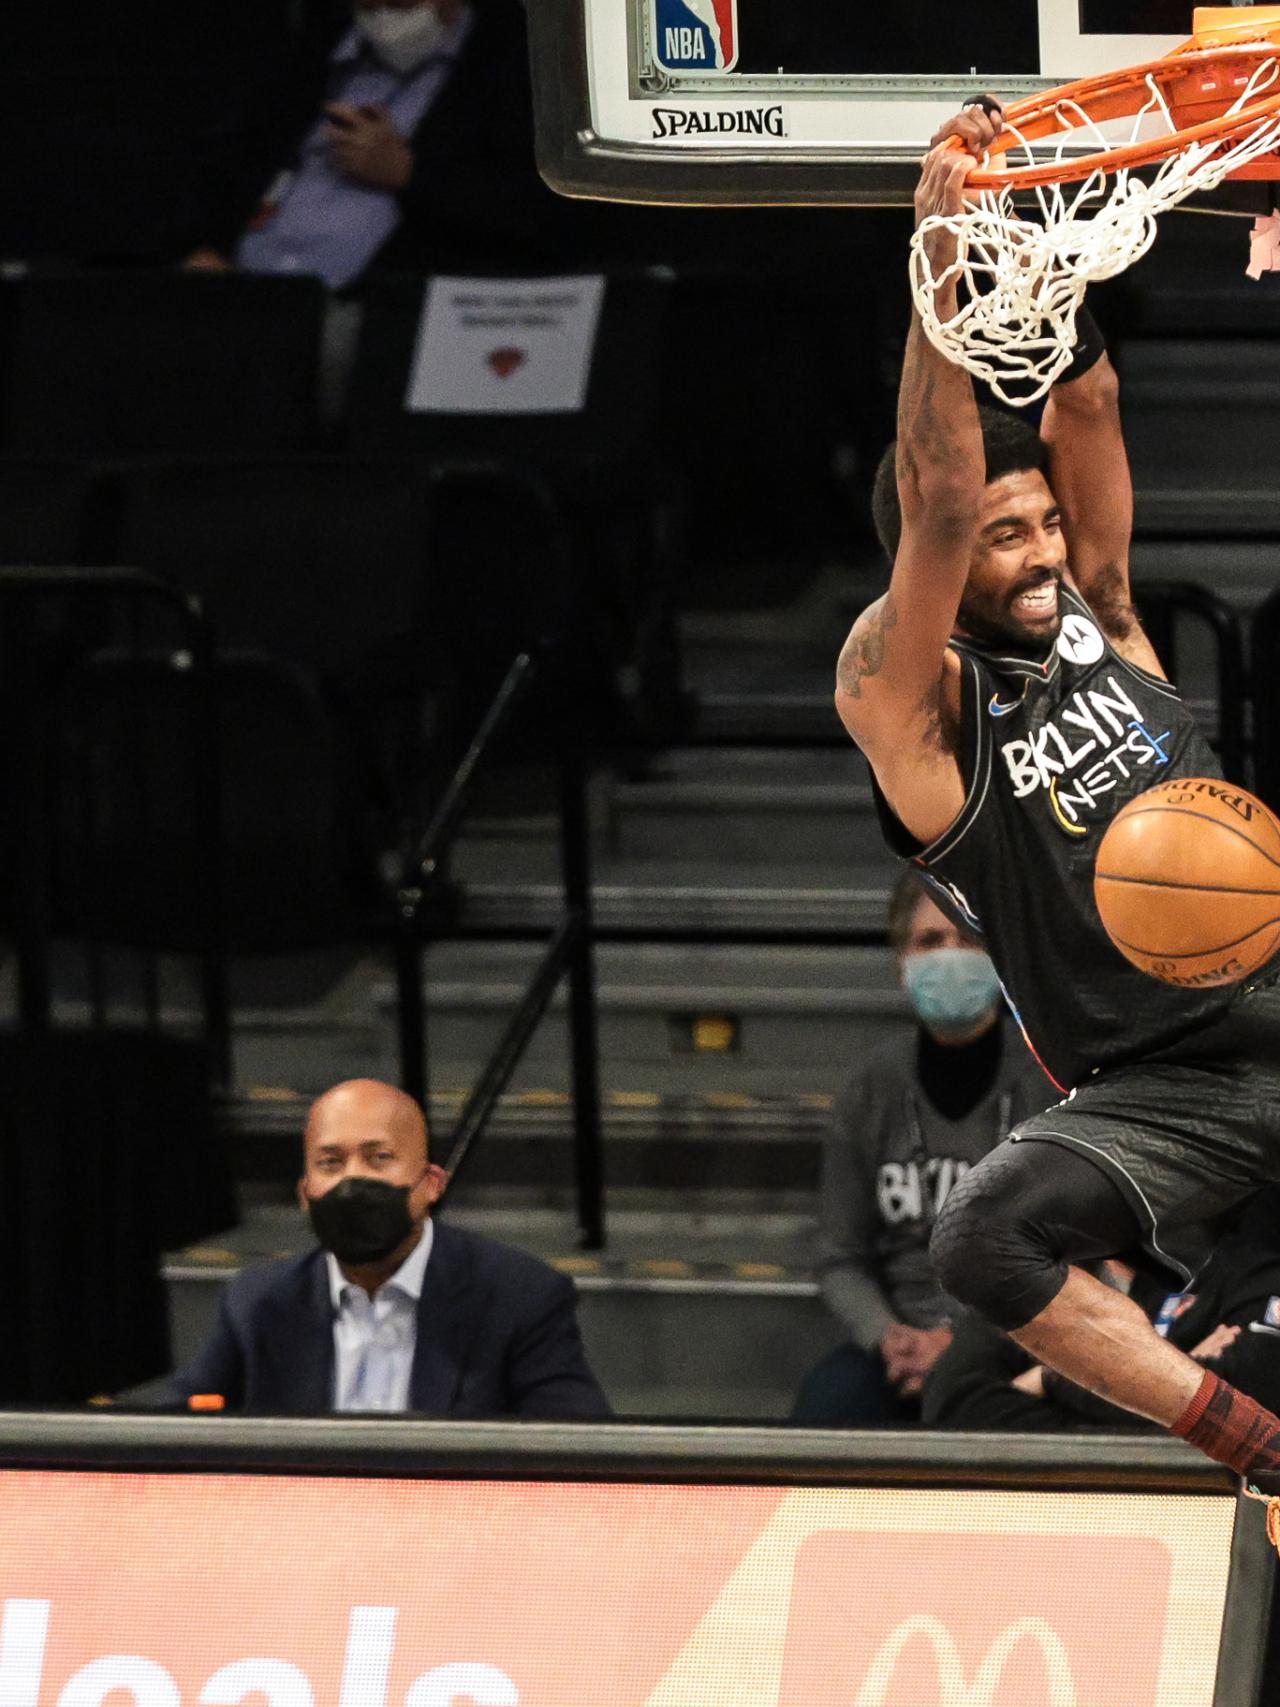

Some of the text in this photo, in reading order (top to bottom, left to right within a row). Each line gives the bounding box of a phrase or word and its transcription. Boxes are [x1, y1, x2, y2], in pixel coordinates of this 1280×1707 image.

[665, 27, 706, 60] NBA
[652, 105, 785, 139] SPALDING
[1001, 676, 1144, 798] BKLYN
[1057, 729, 1157, 822] NETS
